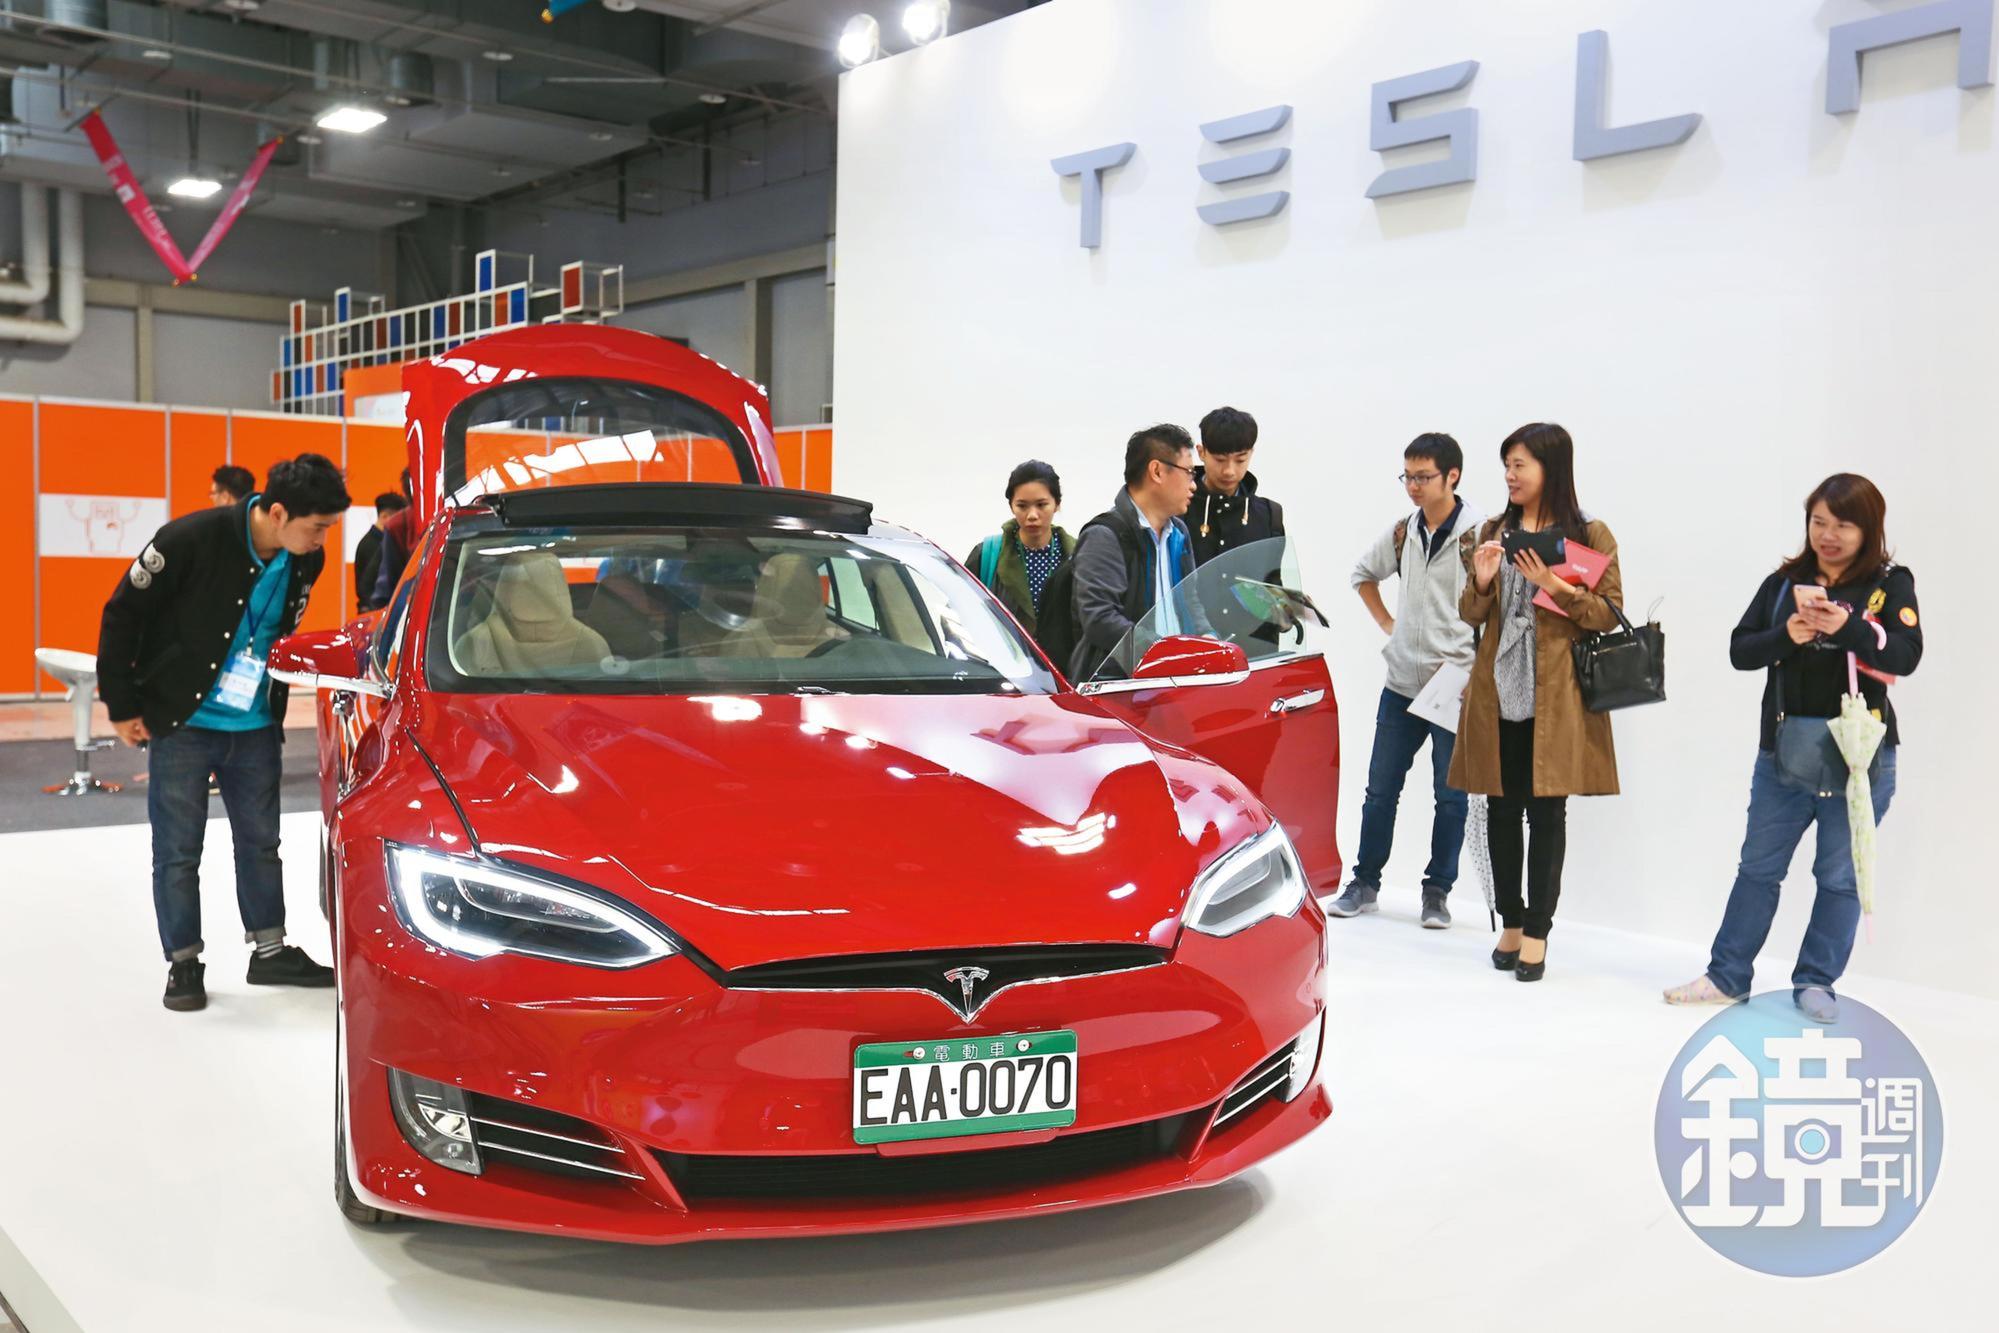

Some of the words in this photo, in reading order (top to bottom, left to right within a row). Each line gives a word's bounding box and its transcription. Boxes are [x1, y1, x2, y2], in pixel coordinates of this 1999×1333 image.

[1050, 0, 1994, 249] TESLA
[933, 1041, 1006, 1062] 電動車
